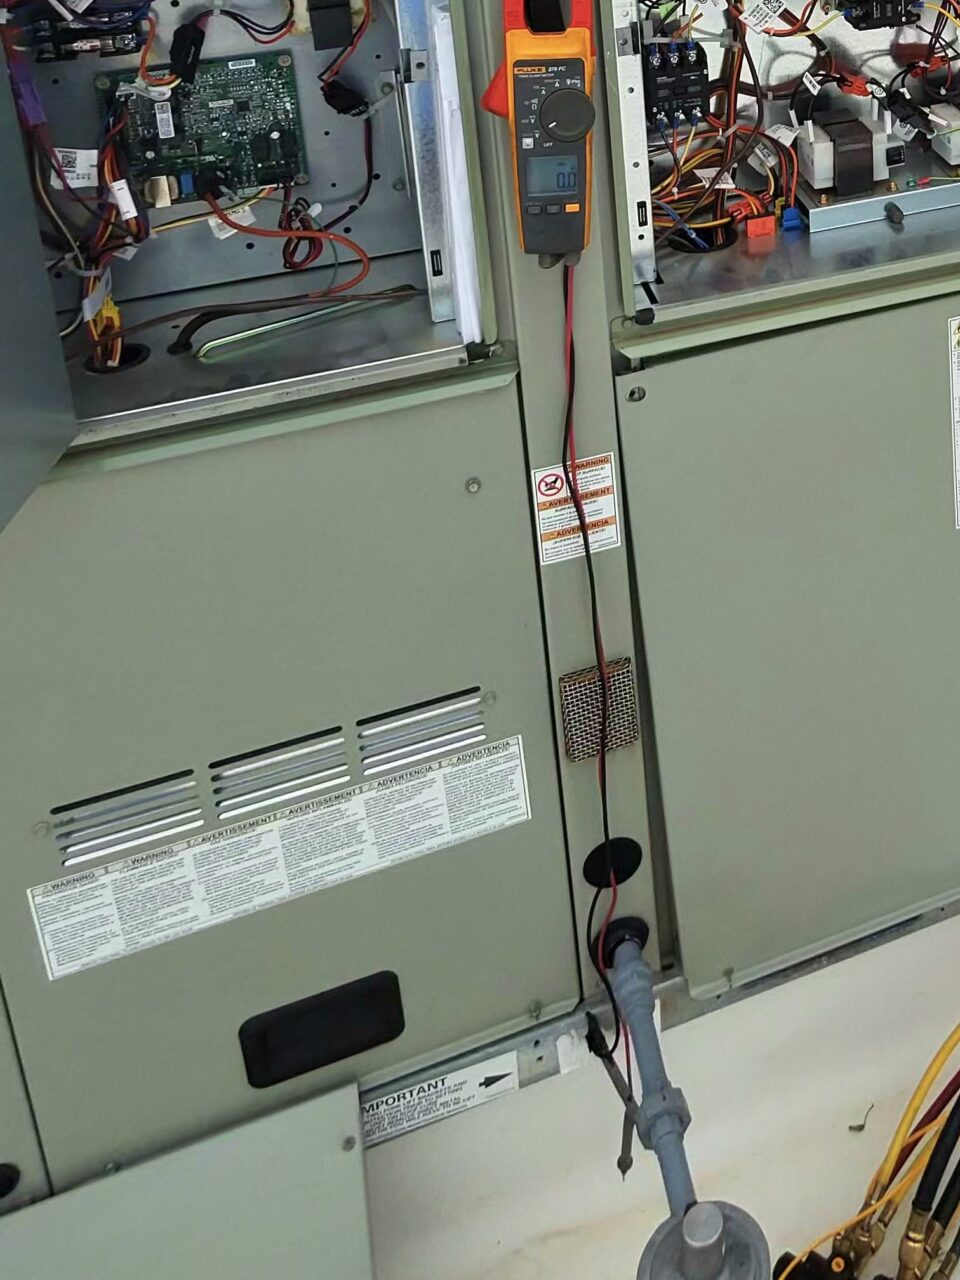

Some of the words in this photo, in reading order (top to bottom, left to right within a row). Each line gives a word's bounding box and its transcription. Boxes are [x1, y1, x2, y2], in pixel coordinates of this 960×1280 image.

[456, 740, 510, 762] ADVERTENCIA
[376, 766, 433, 787] ADVERTENCIA
[288, 790, 356, 816] AVERTISSEMENT
[201, 816, 271, 842] AVERTISSEMENT
[131, 848, 174, 864] WARNING
[50, 872, 96, 890] WARNING
[361, 1076, 447, 1115] MPORTANT
